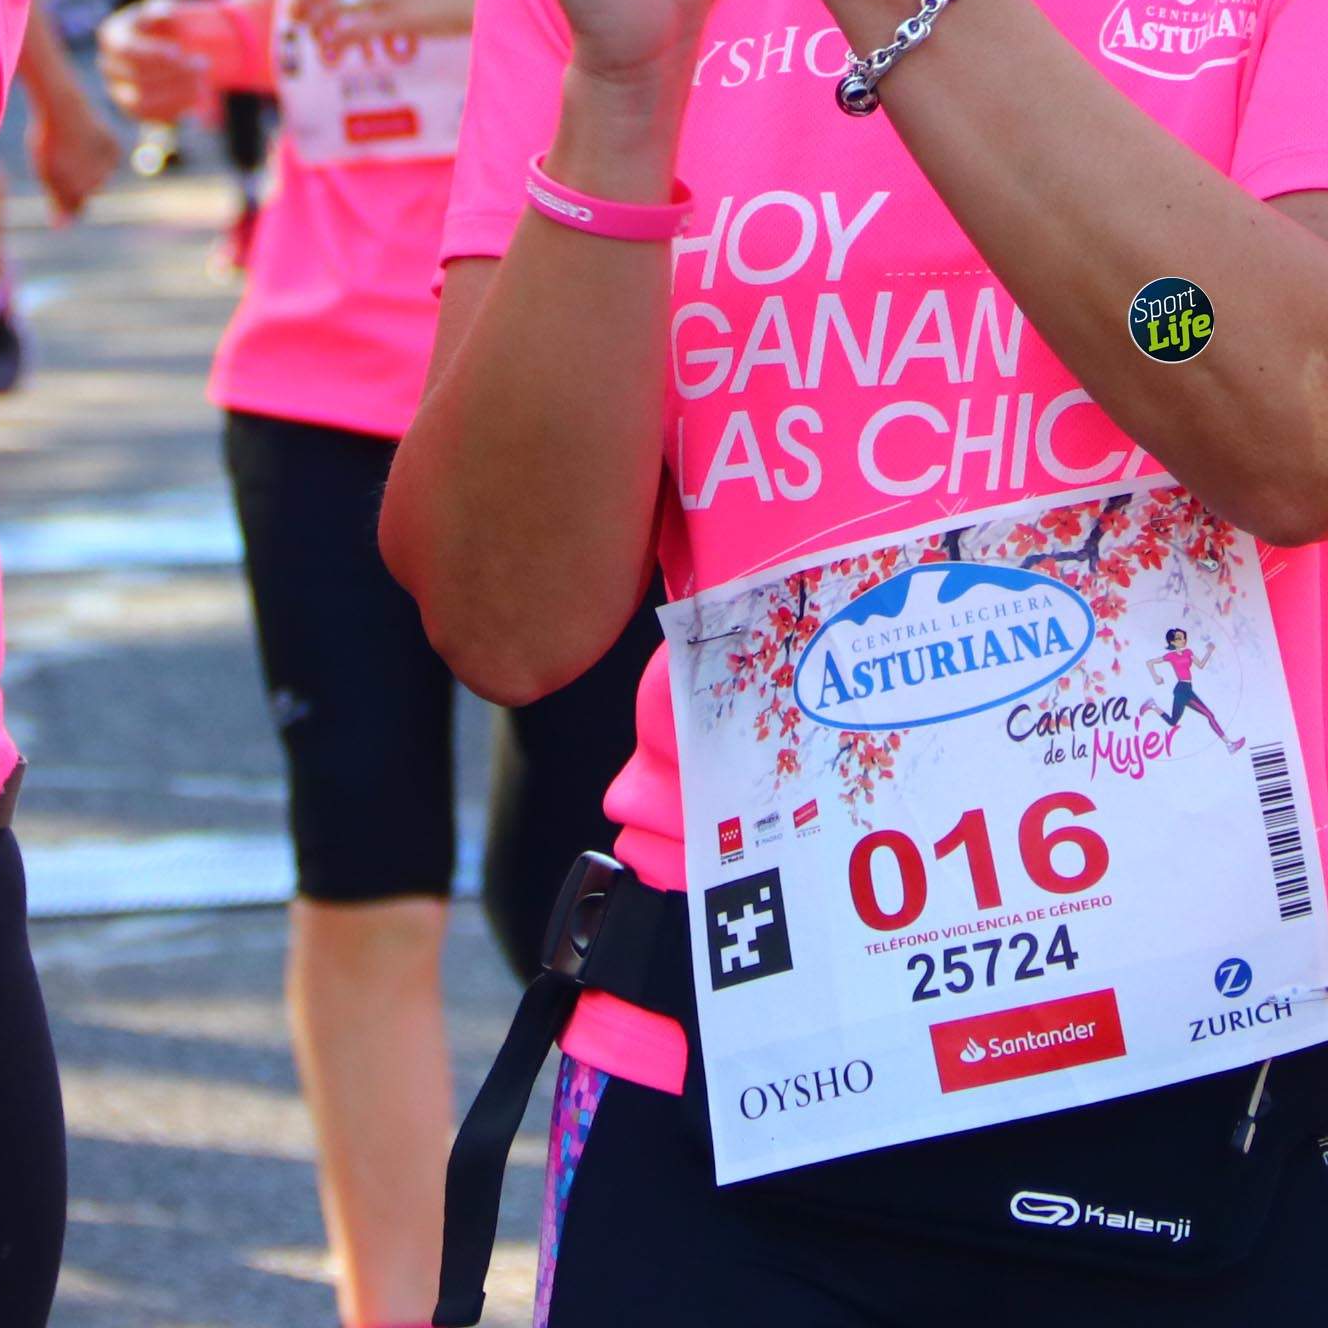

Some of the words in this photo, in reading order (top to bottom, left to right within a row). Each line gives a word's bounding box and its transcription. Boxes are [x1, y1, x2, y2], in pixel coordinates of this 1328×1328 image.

[1145, 5, 1214, 23] CENTRA
[691, 25, 851, 88] YSHO
[672, 189, 890, 291] HOY
[673, 286, 1024, 398] GANAN
[677, 403, 823, 510] LAS
[857, 386, 1149, 495] CHIC
[851, 621, 942, 653] CENTRAL
[949, 595, 1055, 630] LECHERA
[816, 615, 1075, 711] ASTURIANA
[1006, 692, 1133, 742] Carrera
[1043, 740, 1067, 765] de
[1070, 736, 1089, 760] la
[1089, 716, 1183, 781] Mujer
[848, 791, 1111, 932] 016
[864, 929, 940, 956] TELÉFONO
[942, 913, 1023, 939] VIOLENCIA
[1026, 908, 1047, 922] DE
[1049, 894, 1113, 919] GÉNERO
[906, 923, 1080, 1003] 25724
[988, 1018, 1097, 1060] Santander
[1189, 999, 1294, 1043] ZURICH
[738, 1058, 875, 1122] OYSHO
[1084, 1202, 1192, 1243] Kalenji
